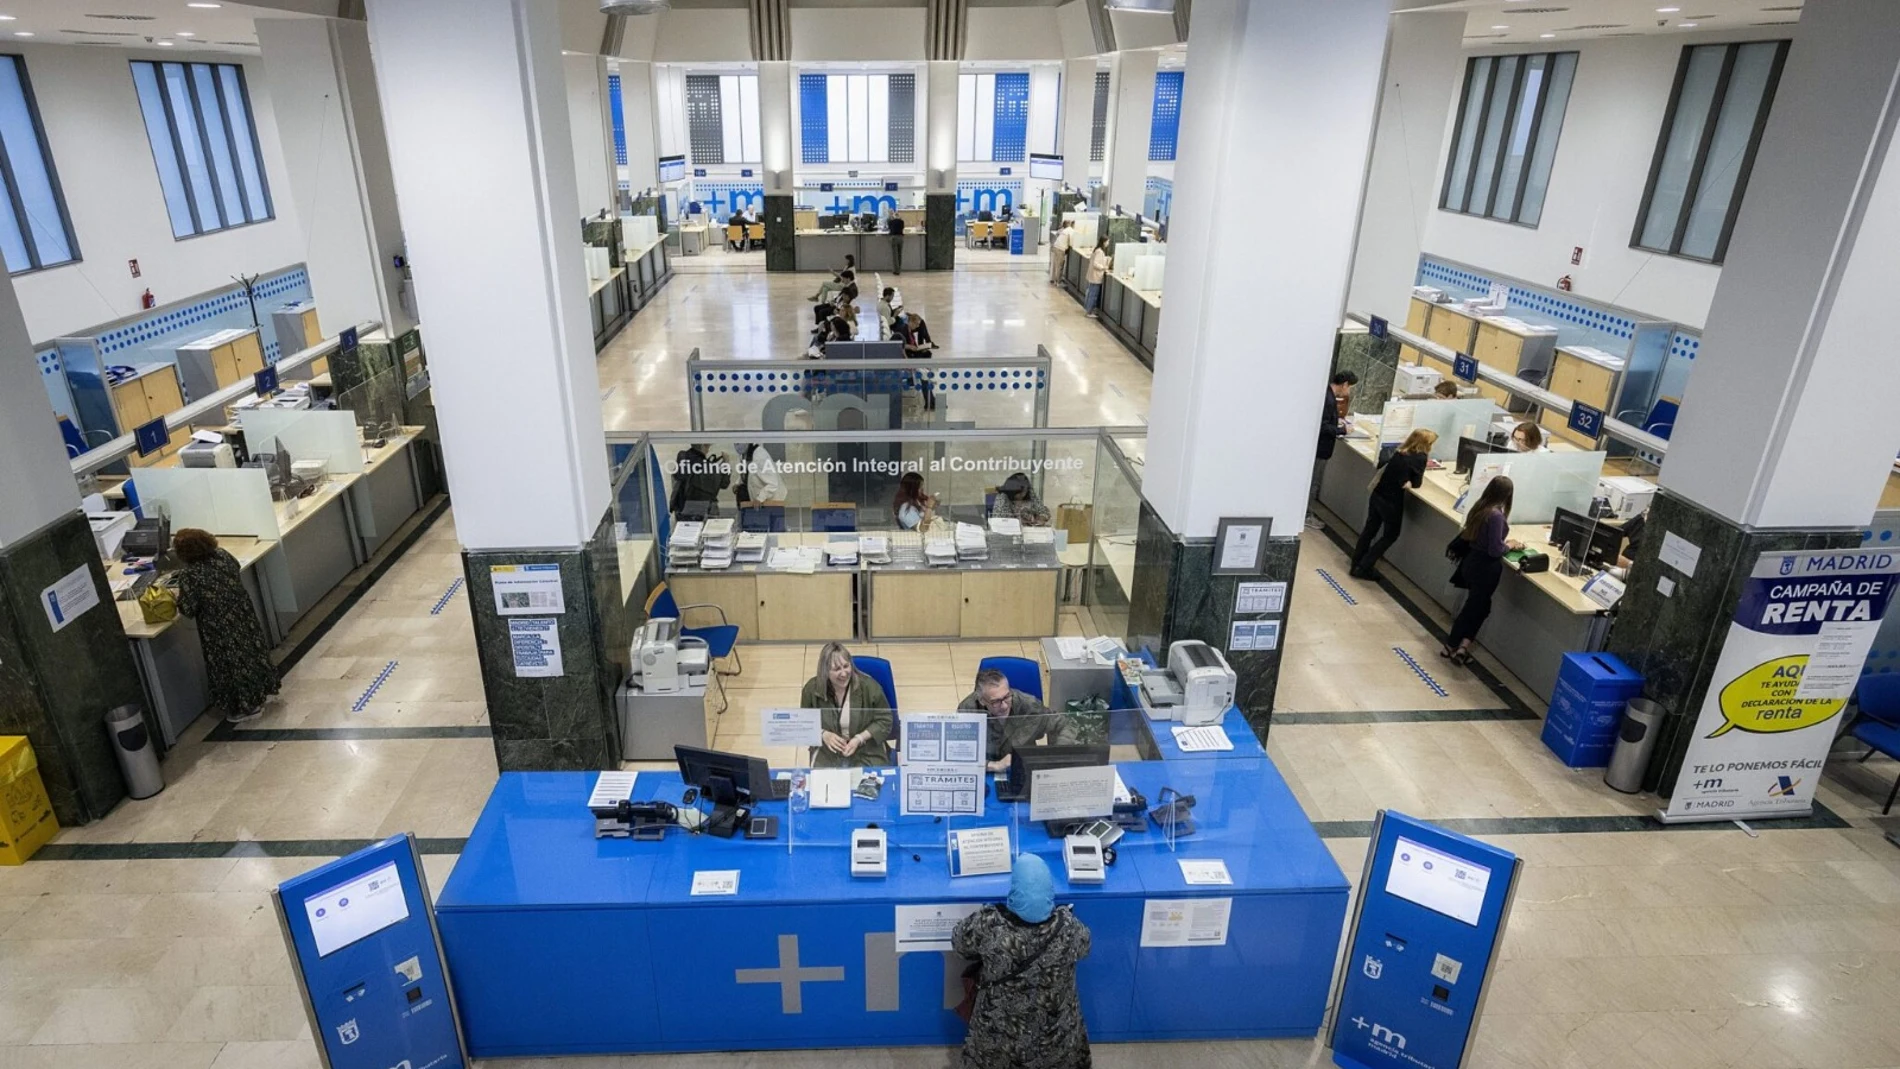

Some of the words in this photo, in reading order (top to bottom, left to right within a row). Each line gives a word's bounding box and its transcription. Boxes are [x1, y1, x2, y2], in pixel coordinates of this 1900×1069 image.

[1459, 361, 1470, 374] 31
[264, 376, 271, 388] 2
[1577, 412, 1593, 429] 32
[151, 430, 157, 444] 1
[665, 458, 731, 475] Oficina
[736, 459, 758, 474] de
[761, 456, 846, 474] Atención
[852, 456, 924, 477] Integral
[930, 456, 945, 472] al
[950, 455, 1083, 476] Contribuyente
[1806, 554, 1892, 572] MADRID
[1769, 580, 1853, 599] CAMPAÑA
[1856, 581, 1883, 595] DE
[1761, 599, 1871, 625] RENTA
[1761, 681, 1771, 689] TE
[1771, 689, 1791, 697] CON
[1756, 707, 1803, 720] renta
[1693, 765, 1708, 774] TE
[1709, 763, 1725, 772] LO
[1726, 760, 1789, 771] PONEMOS
[1790, 758, 1822, 769] FÁCIL
[1693, 778, 1723, 789] +m
[1696, 800, 1735, 808] MADRID
[1351, 1016, 1407, 1050] +m
[1368, 1042, 1398, 1059] madrid
[1369, 1038, 1399, 1055] agencia
